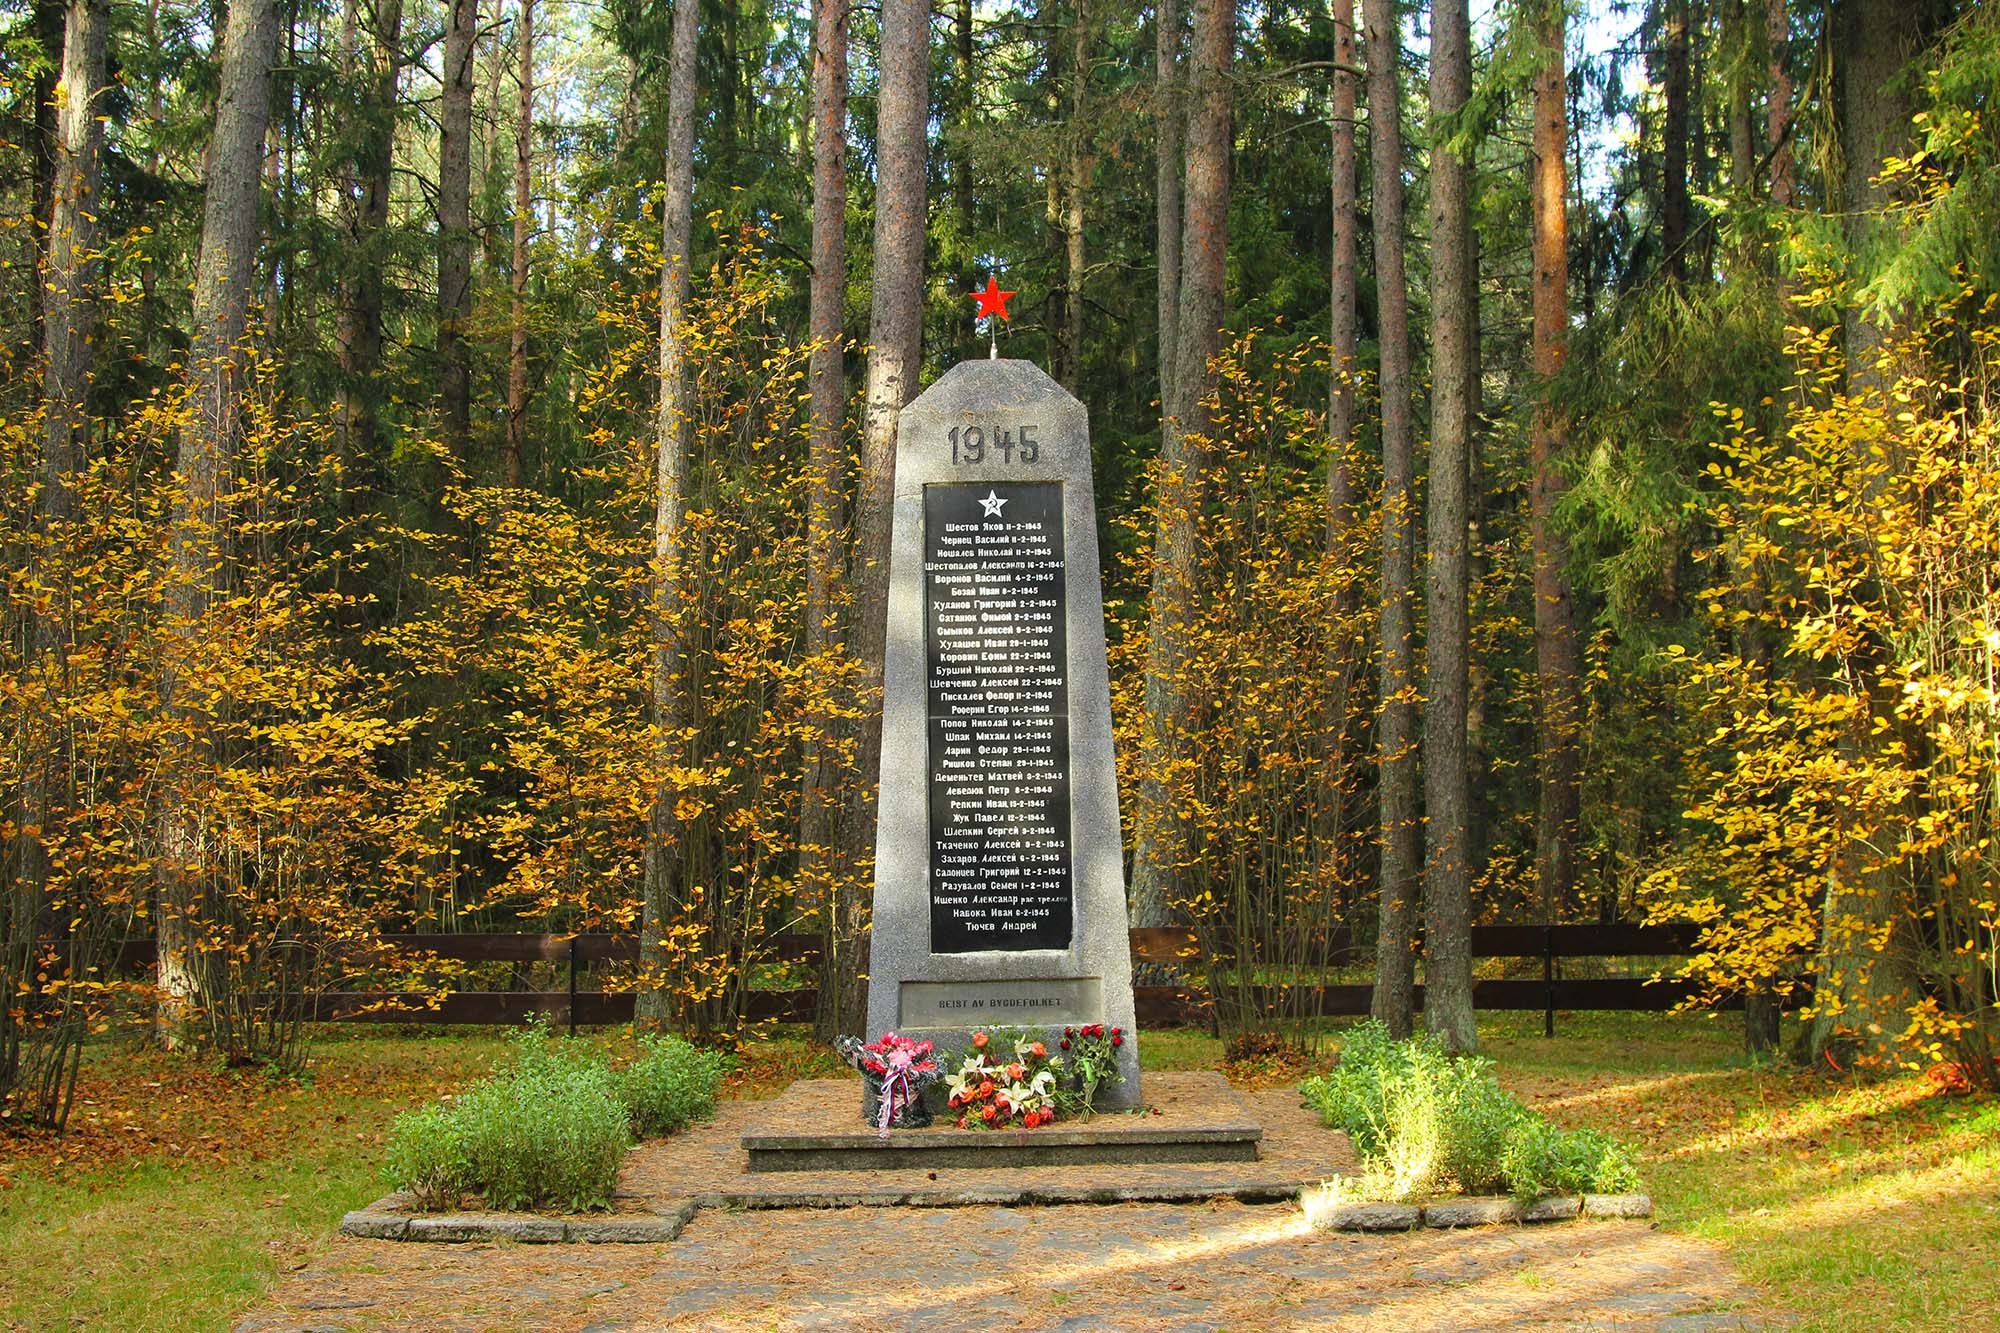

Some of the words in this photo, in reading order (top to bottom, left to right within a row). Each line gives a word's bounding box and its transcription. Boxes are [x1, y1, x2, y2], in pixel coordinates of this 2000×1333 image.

[948, 425, 1039, 465] 1945
[946, 523, 978, 532] Шестов
[984, 522, 1003, 531] Яков
[942, 536, 972, 547] Чернец
[975, 534, 1009, 545] Василий
[978, 547, 1013, 557] Николай
[925, 562, 978, 571] Шестопалов
[975, 573, 1011, 583] Василий
[980, 586, 999, 596] Иван
[974, 598, 1016, 611] Григорий
[937, 626, 973, 636] Смыков
[978, 625, 1013, 635] Алексей
[984, 638, 1007, 648] Иван
[941, 652, 978, 664] Коровин
[975, 664, 1013, 674] Николай
[930, 679, 977, 689] Шевченко
[981, 677, 1019, 688] Алексей
[941, 692, 983, 701] Пискалев
[986, 690, 1014, 702] Федор
[988, 704, 1009, 715] Егор
[941, 719, 966, 729] Попов
[972, 718, 1008, 728] Николай
[946, 732, 970, 742] Шпак
[976, 731, 1010, 741] Михаил
[945, 746, 971, 758] Ларин
[978, 744, 1008, 757] Федор
[980, 758, 1012, 768] Степан
[988, 771, 1023, 781] Матвей
[988, 785, 1009, 797] Петр
[951, 800, 982, 809] Репкин
[987, 799, 1007, 809] Иван
[953, 813, 969, 824] Жук
[975, 813, 1004, 822] Павел
[987, 825, 1018, 838] Сергей
[936, 841, 978, 850] Ткаченко
[984, 839, 1020, 849] Алексей
[942, 854, 977, 866] Захаров
[982, 852, 1016, 863] Алексей
[980, 866, 1019, 879] Григорий
[942, 881, 986, 893] Разувалов
[991, 881, 1017, 890] Семен
[972, 894, 1018, 906] Александр
[954, 908, 986, 918] Набока
[991, 908, 1013, 917] Иван
[966, 921, 995, 931] Тючев
[1002, 921, 1037, 933] Андрей
[939, 999, 968, 1009] REIST
[972, 999, 984, 1008] AV
[989, 998, 1062, 1008] BYGDEFOLKET
